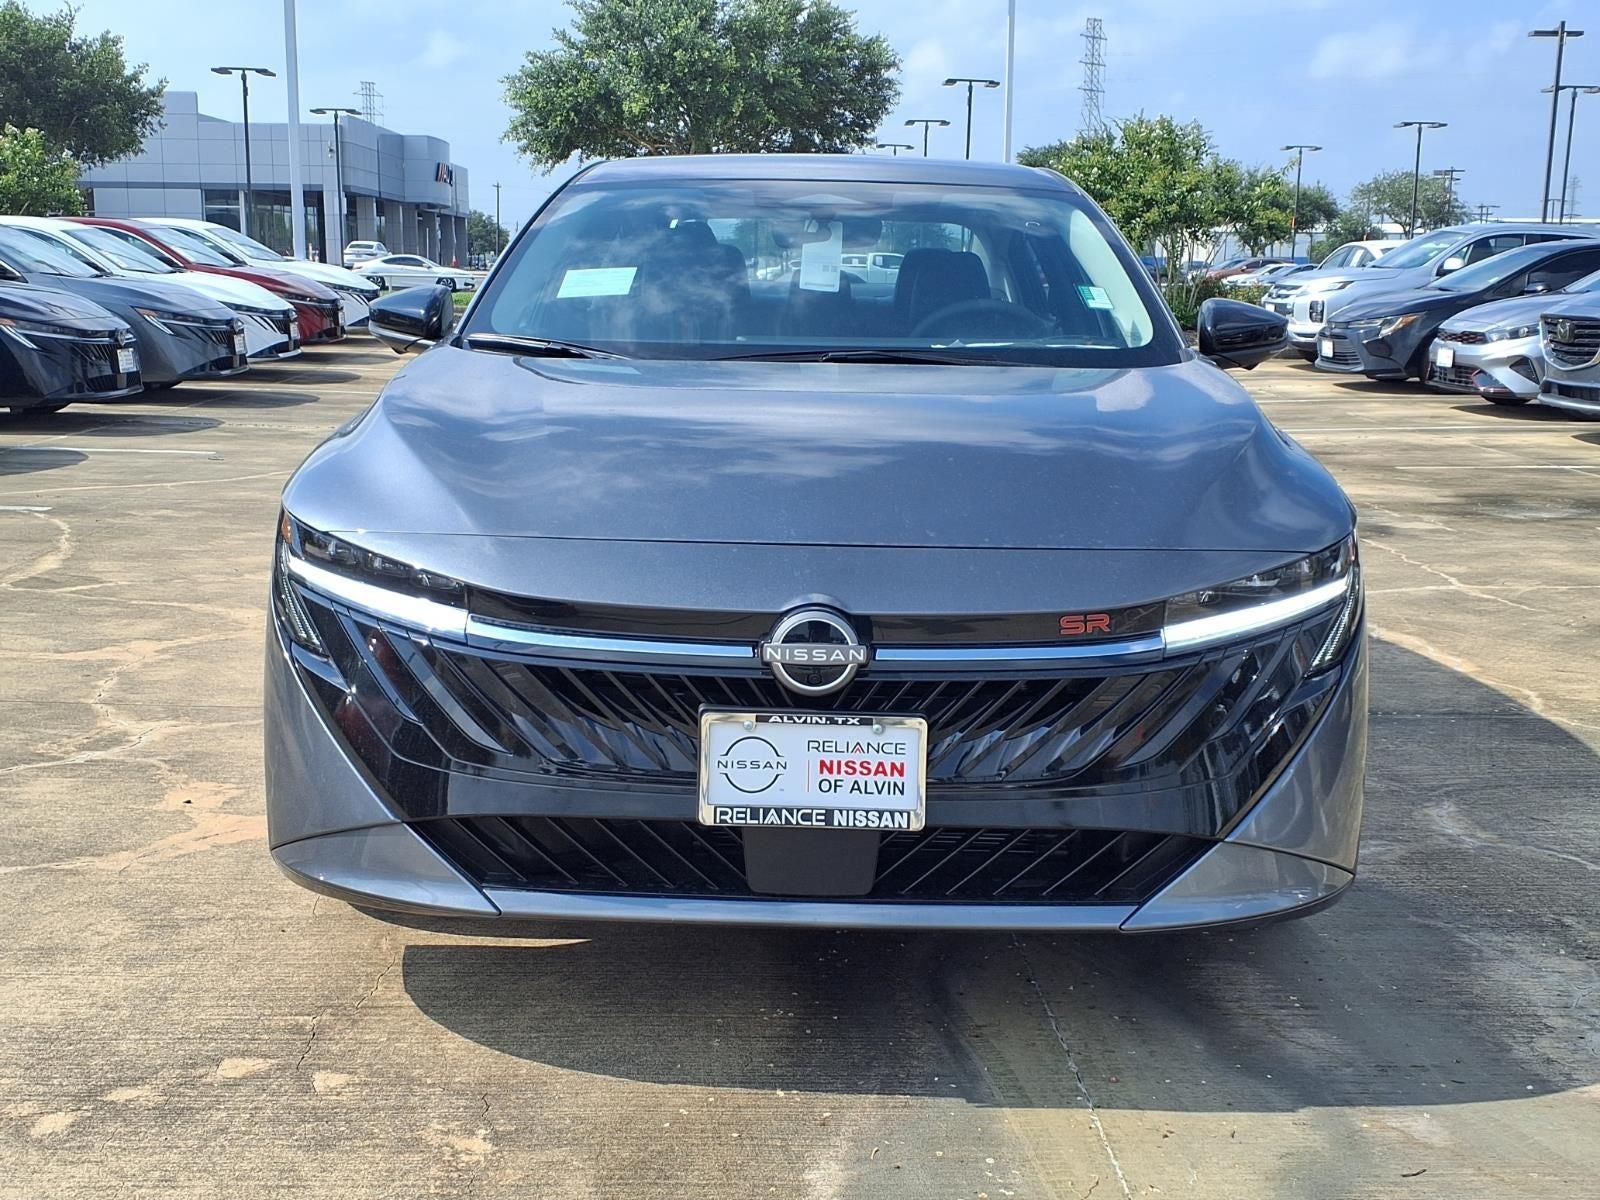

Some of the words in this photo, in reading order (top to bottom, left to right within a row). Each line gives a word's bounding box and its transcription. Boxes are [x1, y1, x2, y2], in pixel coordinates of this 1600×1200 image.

[1060, 614, 1111, 635] SR
[766, 647, 865, 662] NISSAN
[834, 717, 860, 725] TX
[807, 740, 906, 755] RELIANCE
[717, 760, 788, 770] NISSAN
[819, 759, 905, 777] NISSAN
[818, 778, 844, 794] OF
[849, 780, 905, 796] ALVIN
[716, 807, 826, 826] RELIANCE
[833, 809, 909, 829] NISSAN
